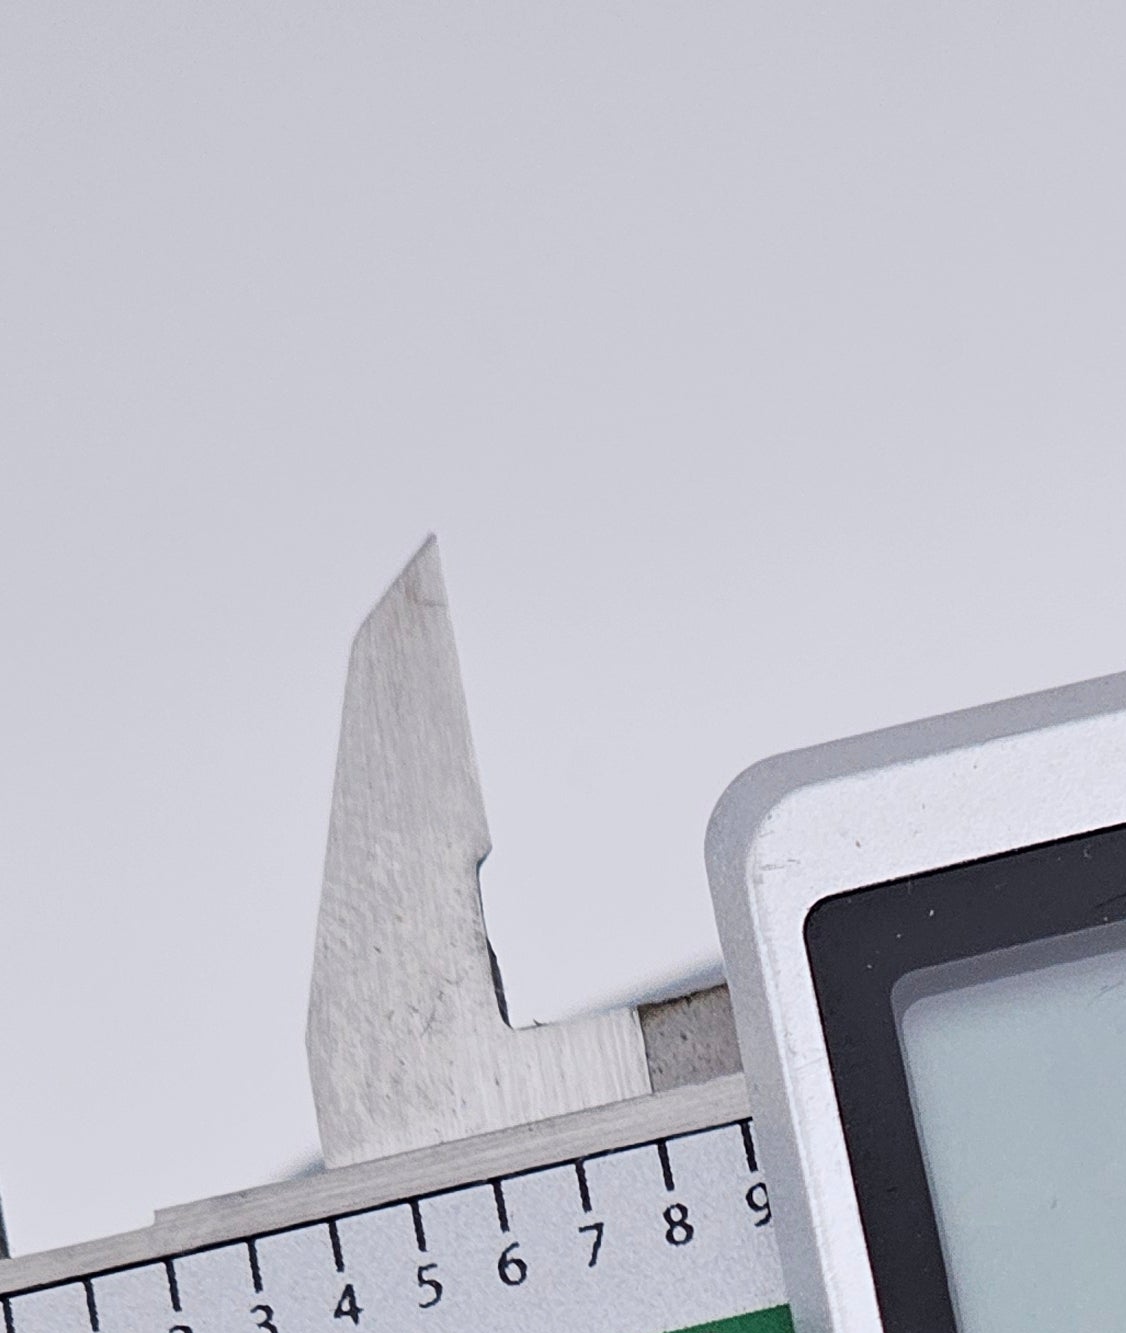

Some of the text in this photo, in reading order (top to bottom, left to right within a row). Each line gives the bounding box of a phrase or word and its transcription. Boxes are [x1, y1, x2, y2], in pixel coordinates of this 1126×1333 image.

[333, 1283, 364, 1325] 4
[416, 1263, 444, 1309] 5
[496, 1243, 529, 1287] 6
[577, 1222, 605, 1268] 7
[662, 1202, 695, 1246] 8
[745, 1180, 773, 1228] 9
